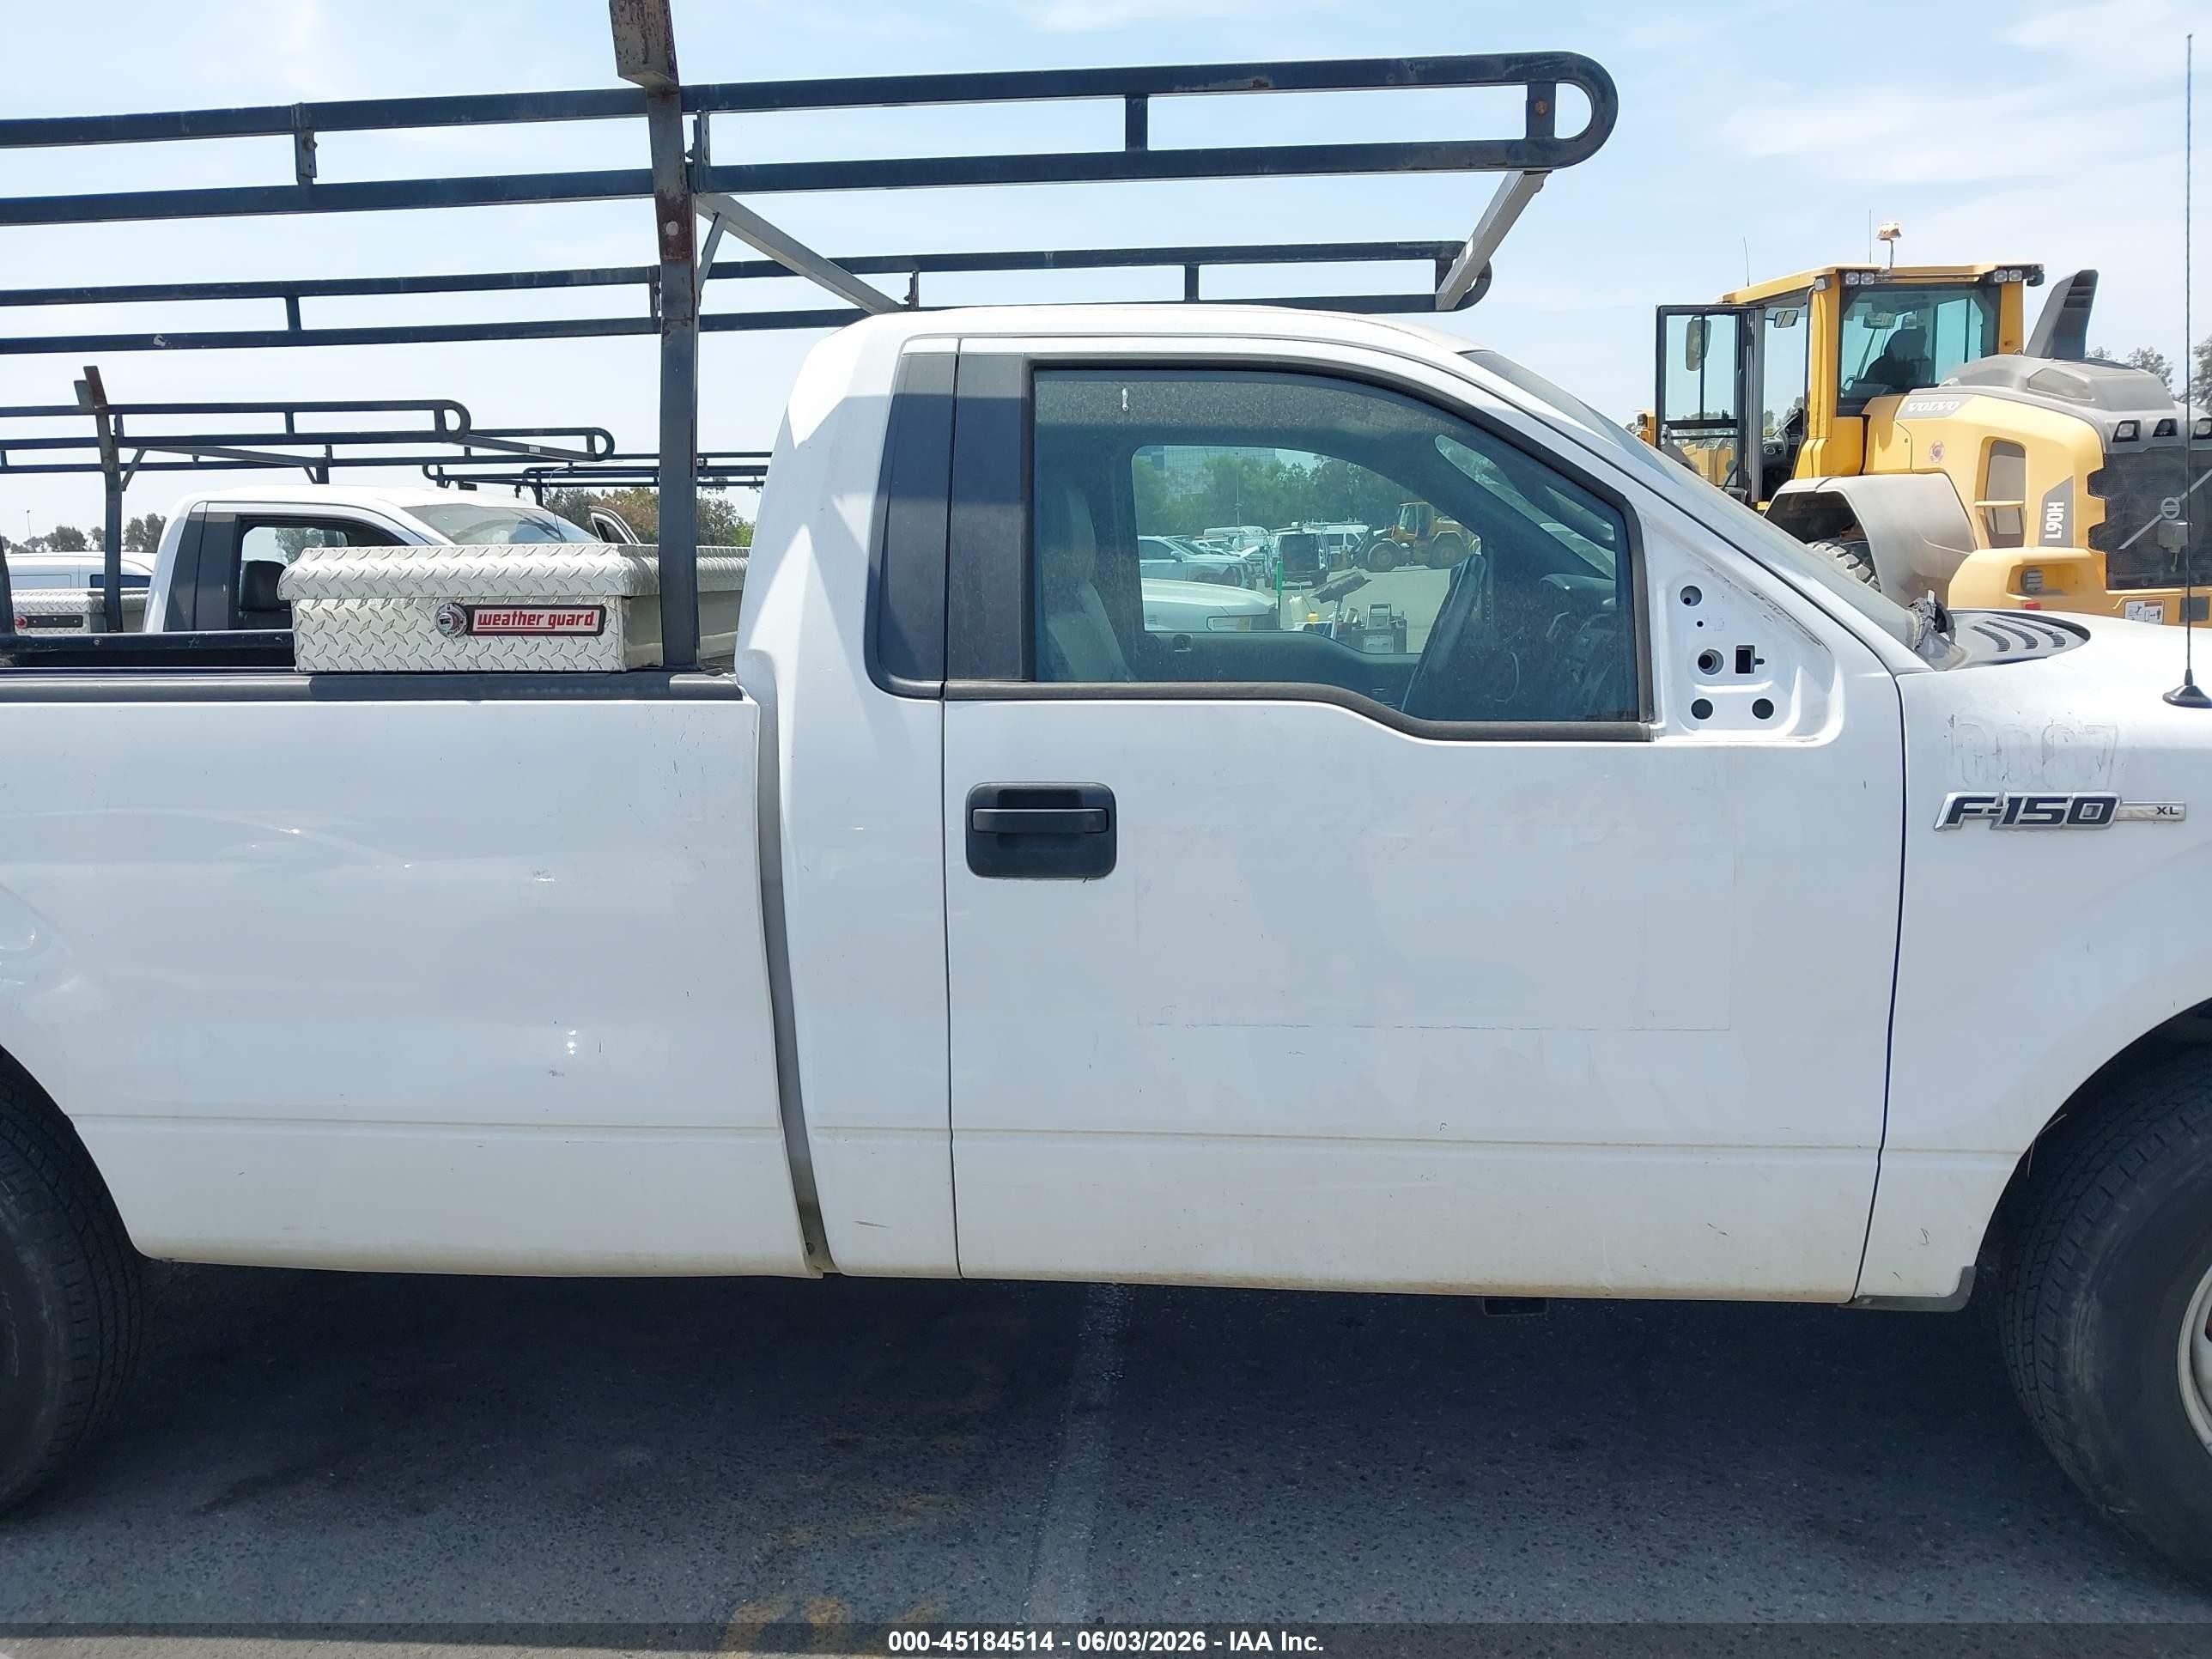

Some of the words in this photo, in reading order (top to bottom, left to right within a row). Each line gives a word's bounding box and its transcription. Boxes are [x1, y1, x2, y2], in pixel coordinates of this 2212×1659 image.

[1908, 400, 1960, 412] VOLVO
[2045, 501, 2065, 538] L90H
[477, 611, 544, 626] weather
[549, 611, 595, 629] guard
[1935, 792, 2122, 830] F-150
[2156, 805, 2180, 815] XL
